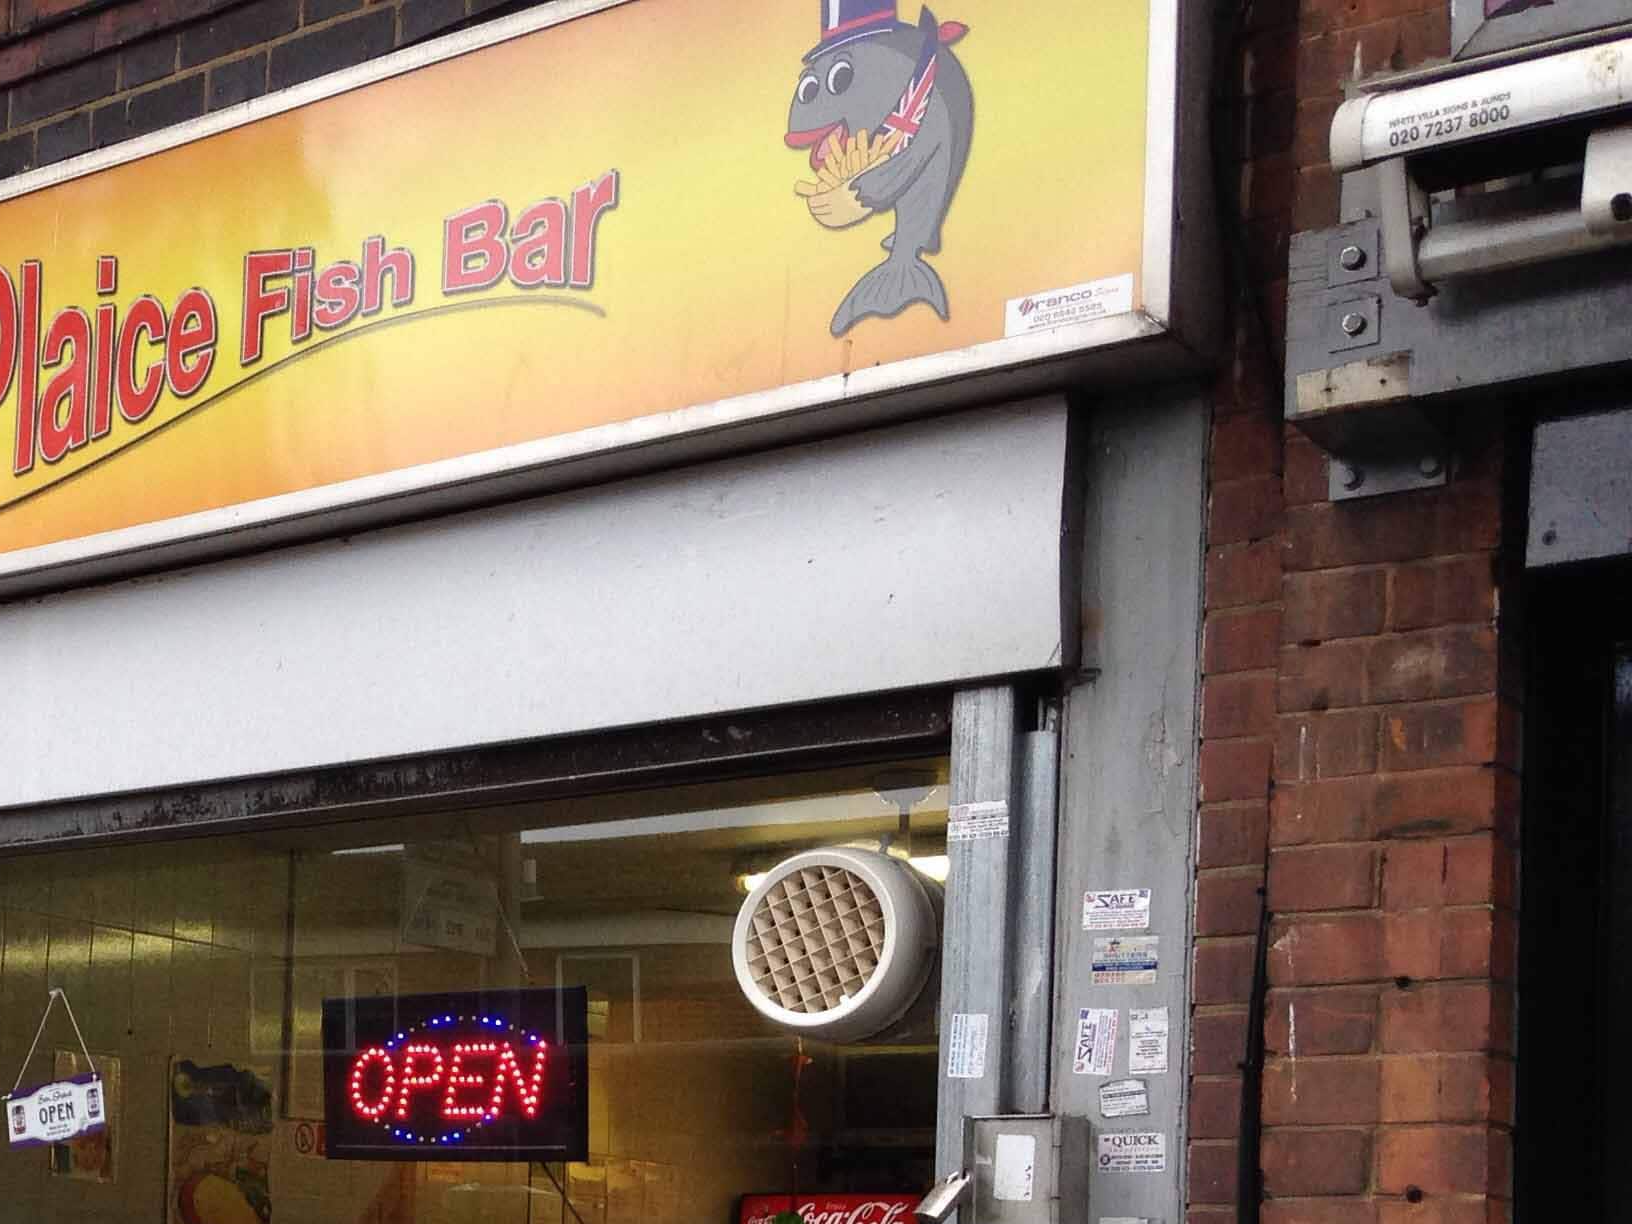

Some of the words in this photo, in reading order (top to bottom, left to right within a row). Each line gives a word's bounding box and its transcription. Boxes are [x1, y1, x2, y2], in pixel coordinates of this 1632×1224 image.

[1389, 126, 1419, 147] 020
[1424, 116, 1464, 138] 7237
[1469, 105, 1510, 128] 8000
[241, 235, 414, 366] Fish
[441, 168, 618, 294] Bar
[349, 1037, 549, 1120] OPEN
[39, 1101, 75, 1126] OPEN
